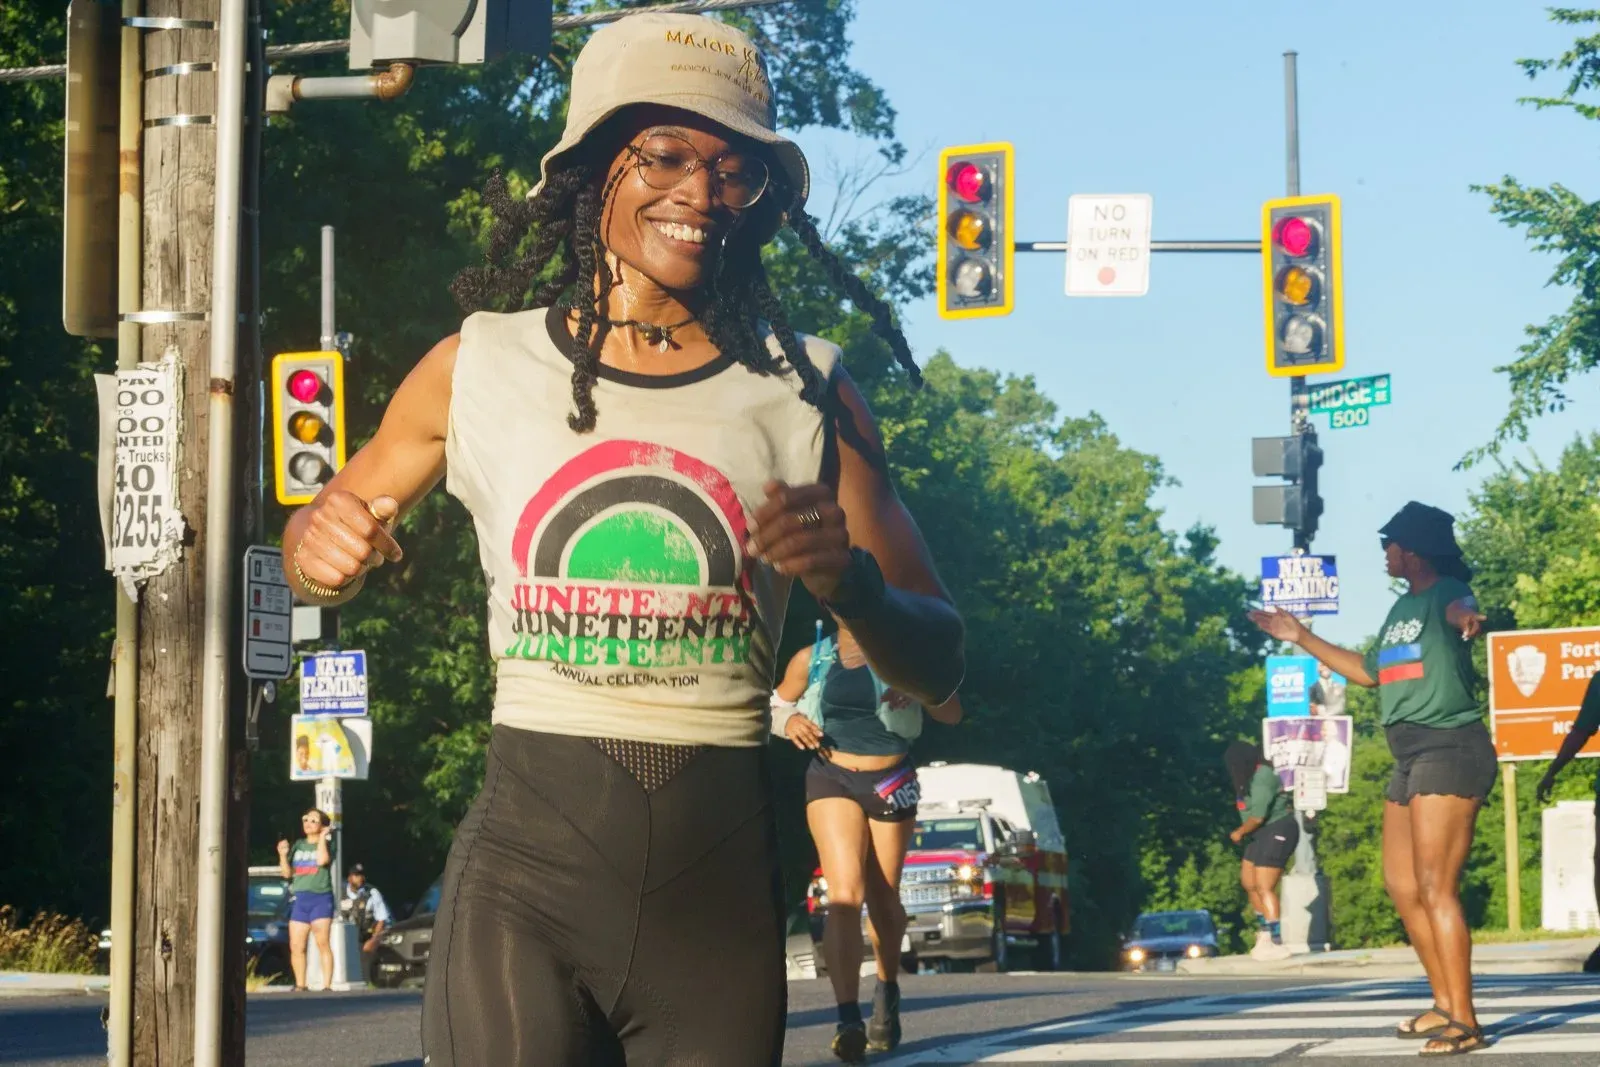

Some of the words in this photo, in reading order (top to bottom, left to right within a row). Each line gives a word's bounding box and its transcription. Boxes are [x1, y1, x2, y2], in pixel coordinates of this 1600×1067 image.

[666, 30, 737, 57] MAJOR
[1094, 204, 1126, 221] NO
[1088, 227, 1132, 241] TURN
[1076, 247, 1099, 262] ON
[1107, 247, 1139, 261] RED
[1332, 407, 1368, 428] 500
[116, 435, 164, 447] NTED
[1262, 576, 1339, 602] FLEMING
[315, 656, 355, 677] NATE
[551, 662, 603, 686] ANNUAL
[607, 673, 699, 688] CELEBRATION
[303, 675, 365, 698] FLEMING
